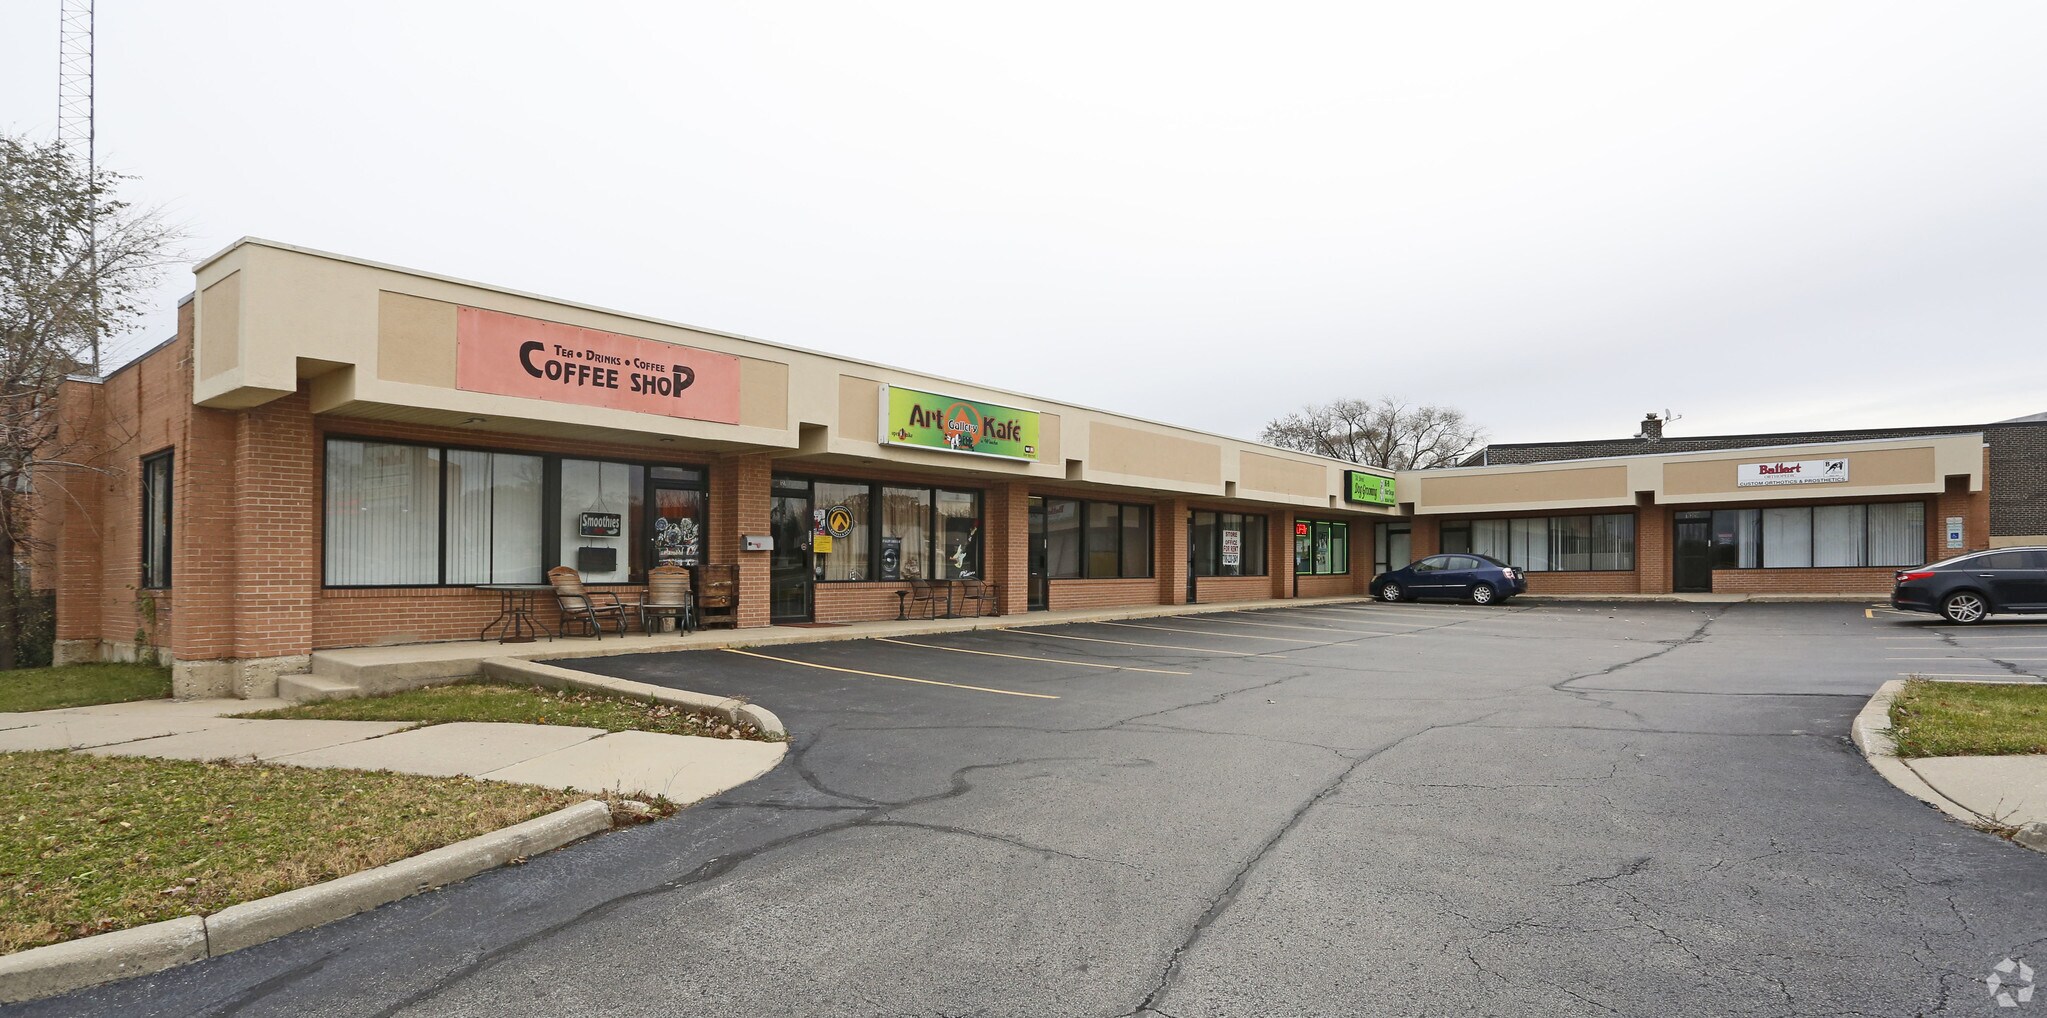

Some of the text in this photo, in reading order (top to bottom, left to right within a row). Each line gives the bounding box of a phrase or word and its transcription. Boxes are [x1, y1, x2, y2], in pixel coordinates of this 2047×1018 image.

[519, 341, 695, 398] COFFEE SHOP
[909, 404, 944, 430] Art
[948, 419, 978, 433] Gallery
[582, 514, 619, 529] Smoothies
